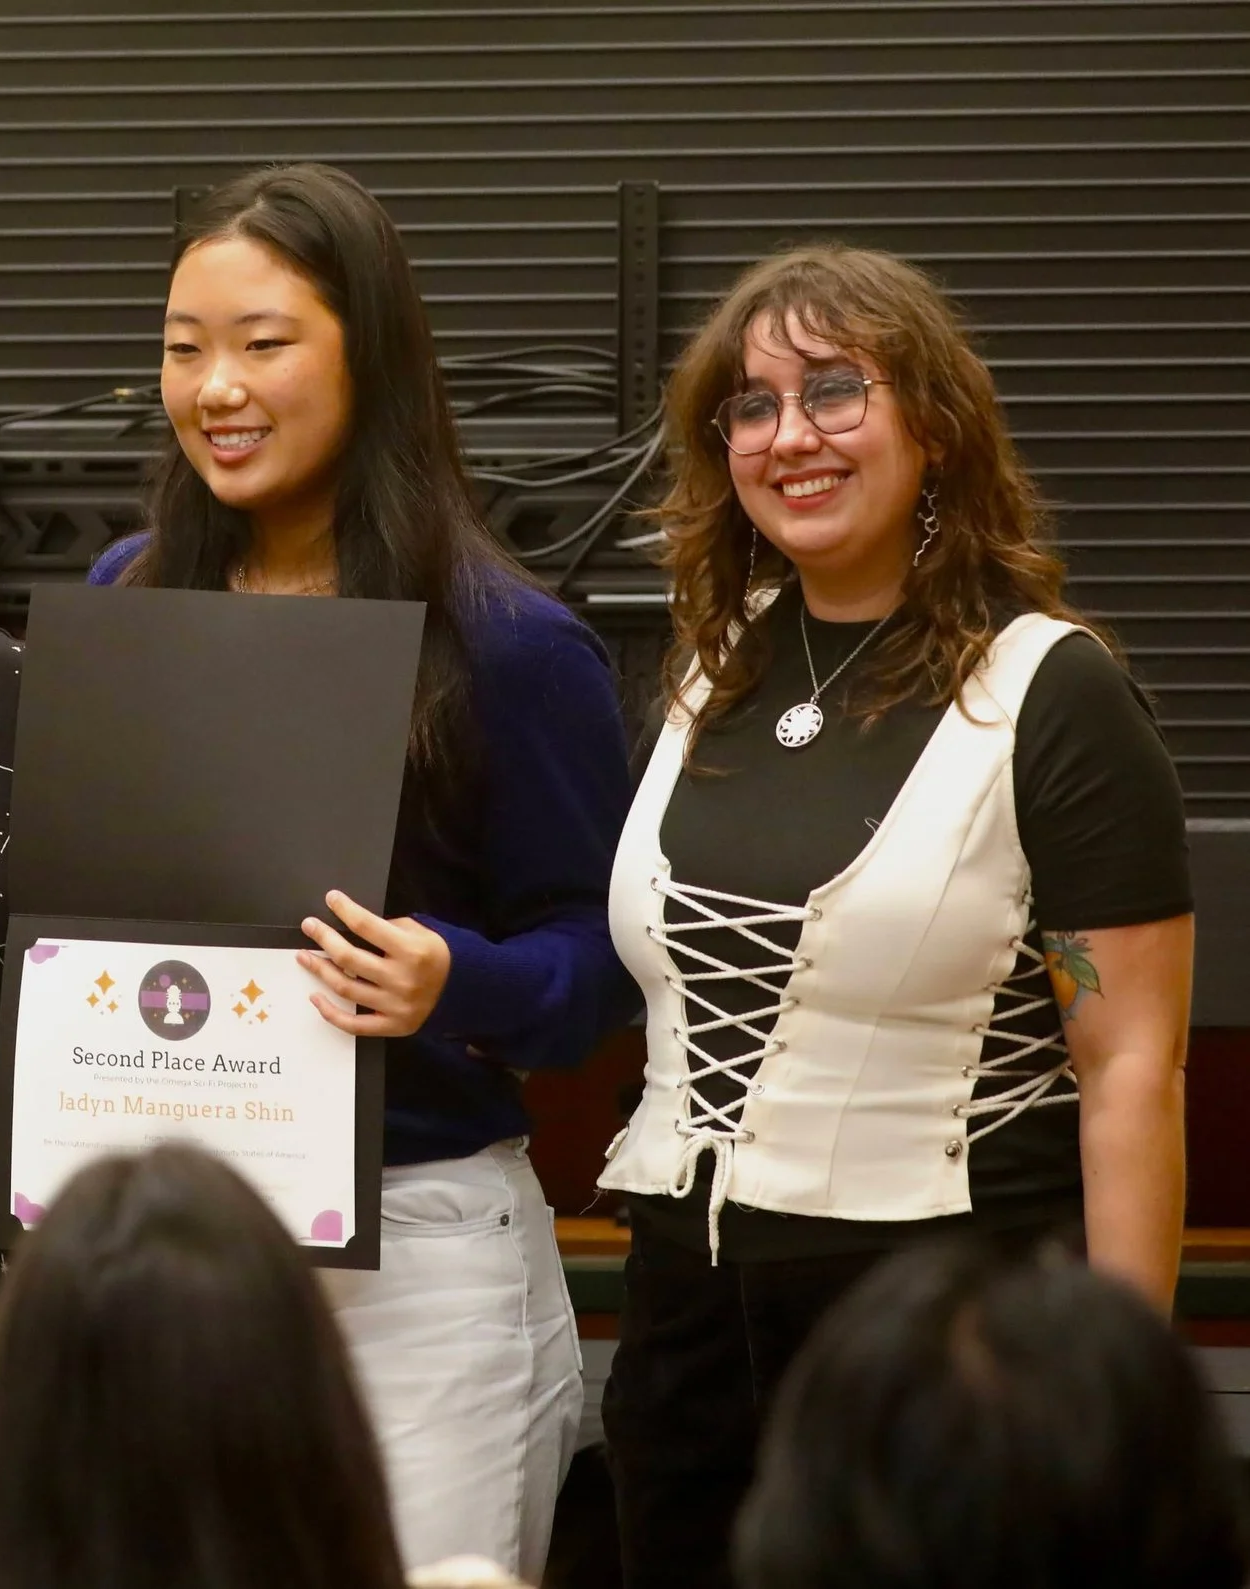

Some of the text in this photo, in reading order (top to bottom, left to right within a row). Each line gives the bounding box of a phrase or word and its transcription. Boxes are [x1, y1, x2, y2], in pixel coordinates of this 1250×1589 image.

[72, 1046, 282, 1075] Second Place Award
[93, 1073, 133, 1084] Presented
[135, 1076, 145, 1086] by
[146, 1077, 159, 1085] the
[161, 1078, 192, 1088] Omega
[217, 1080, 247, 1090] Project
[248, 1081, 258, 1089] to
[59, 1091, 294, 1122] Jadyn Manguera Shin
